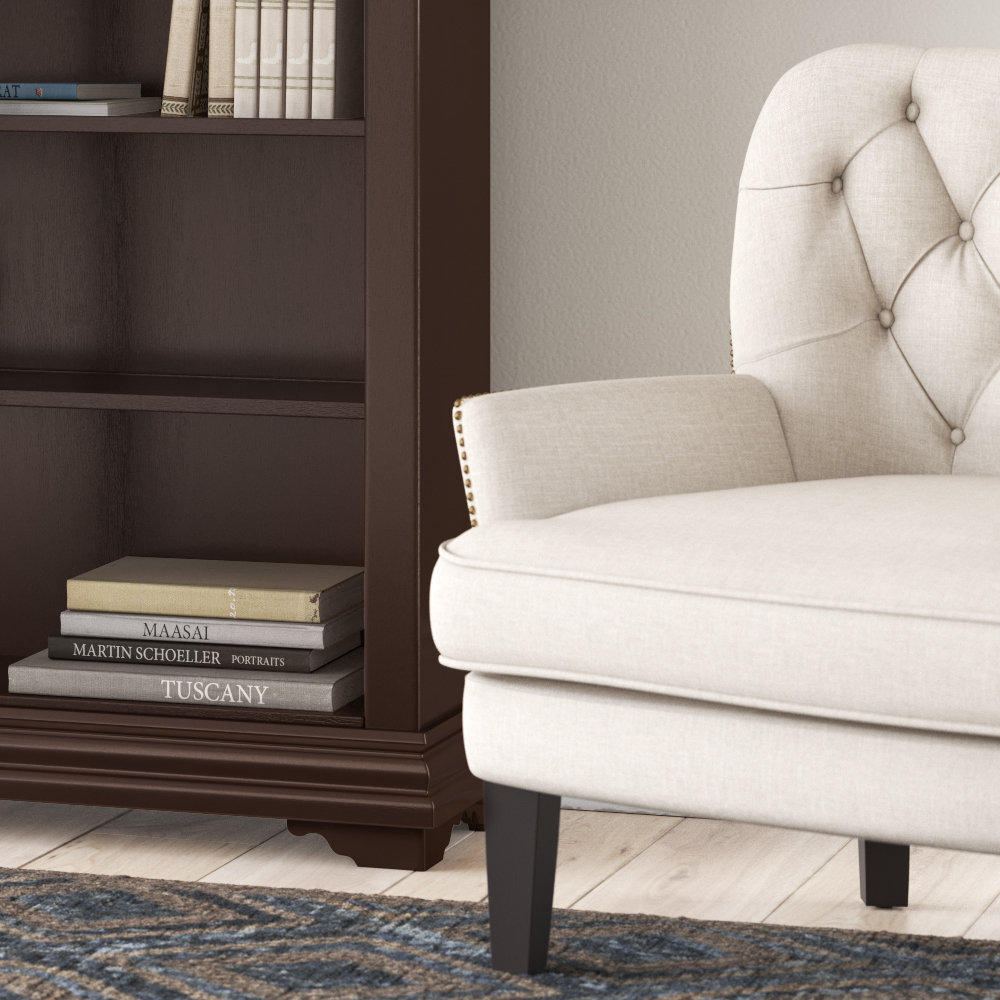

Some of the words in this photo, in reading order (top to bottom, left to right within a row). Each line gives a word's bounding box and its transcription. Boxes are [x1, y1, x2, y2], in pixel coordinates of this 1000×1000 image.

[142, 622, 210, 640] MAASAI
[73, 642, 133, 660] MARTIN
[135, 646, 221, 665] SCHOELLER
[231, 654, 285, 668] PORTRAITS
[161, 679, 269, 705] TUSCANY
